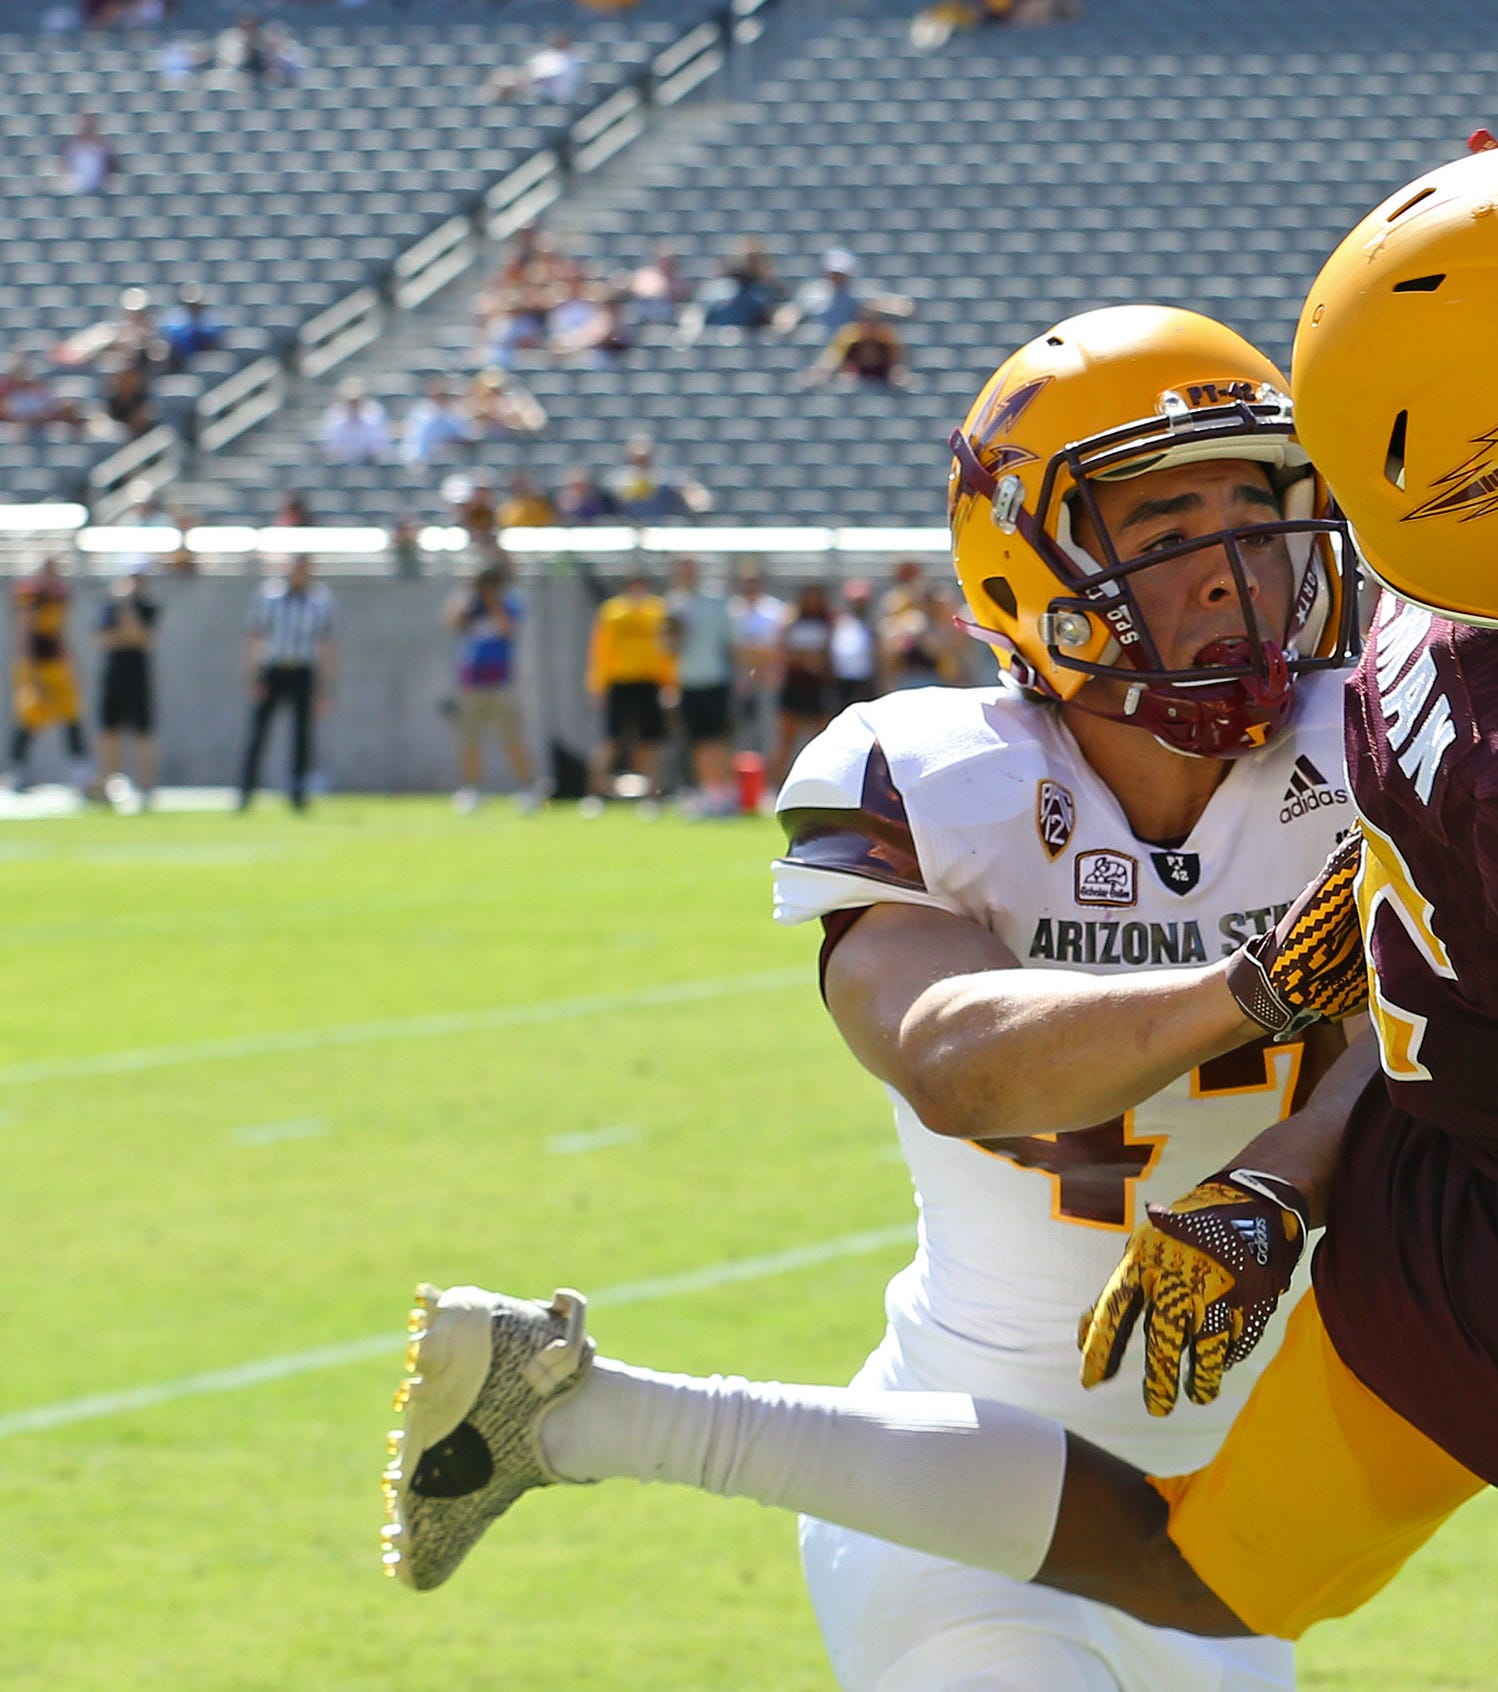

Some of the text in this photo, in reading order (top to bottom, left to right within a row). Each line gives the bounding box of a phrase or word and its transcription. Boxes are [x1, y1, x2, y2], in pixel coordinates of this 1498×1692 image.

[1187, 381, 1256, 406] PT-42
[1279, 788, 1348, 824] adidas
[1044, 814, 1066, 846] 12
[1170, 870, 1190, 883] 42
[1028, 917, 1208, 965] ARIZONA
